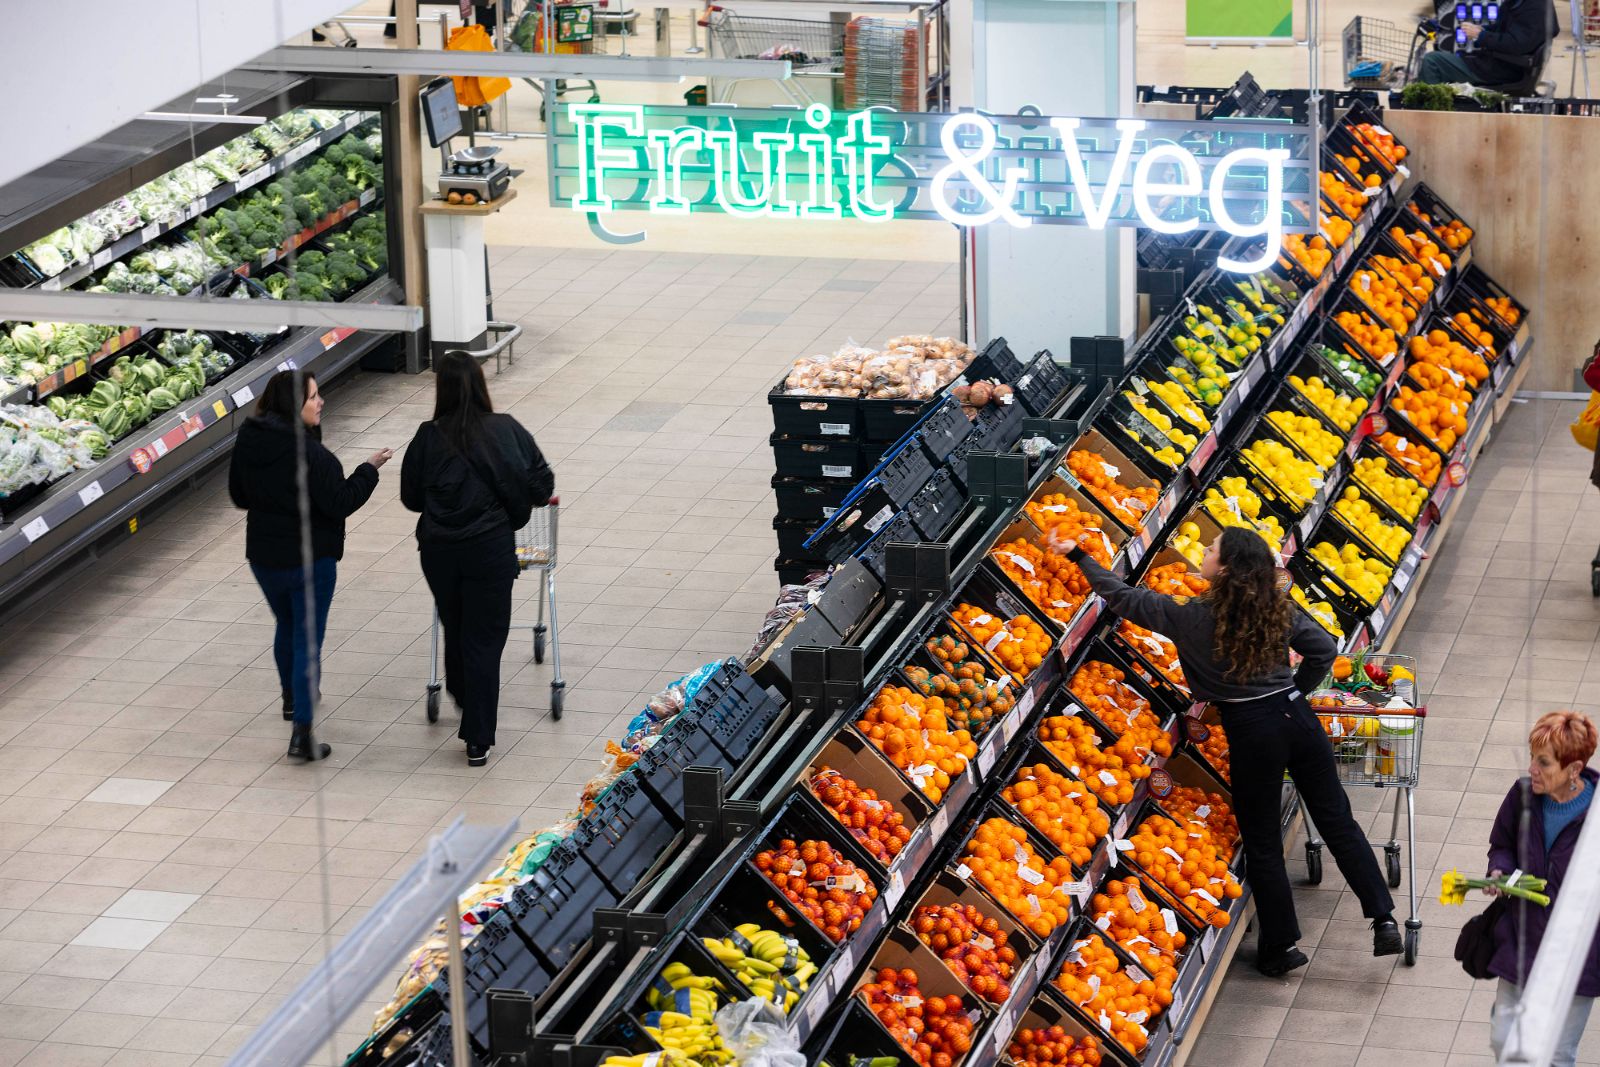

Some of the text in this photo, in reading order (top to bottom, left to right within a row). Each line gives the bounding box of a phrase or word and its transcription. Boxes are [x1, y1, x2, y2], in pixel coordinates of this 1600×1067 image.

[568, 103, 1294, 273] Fruit & Veg
